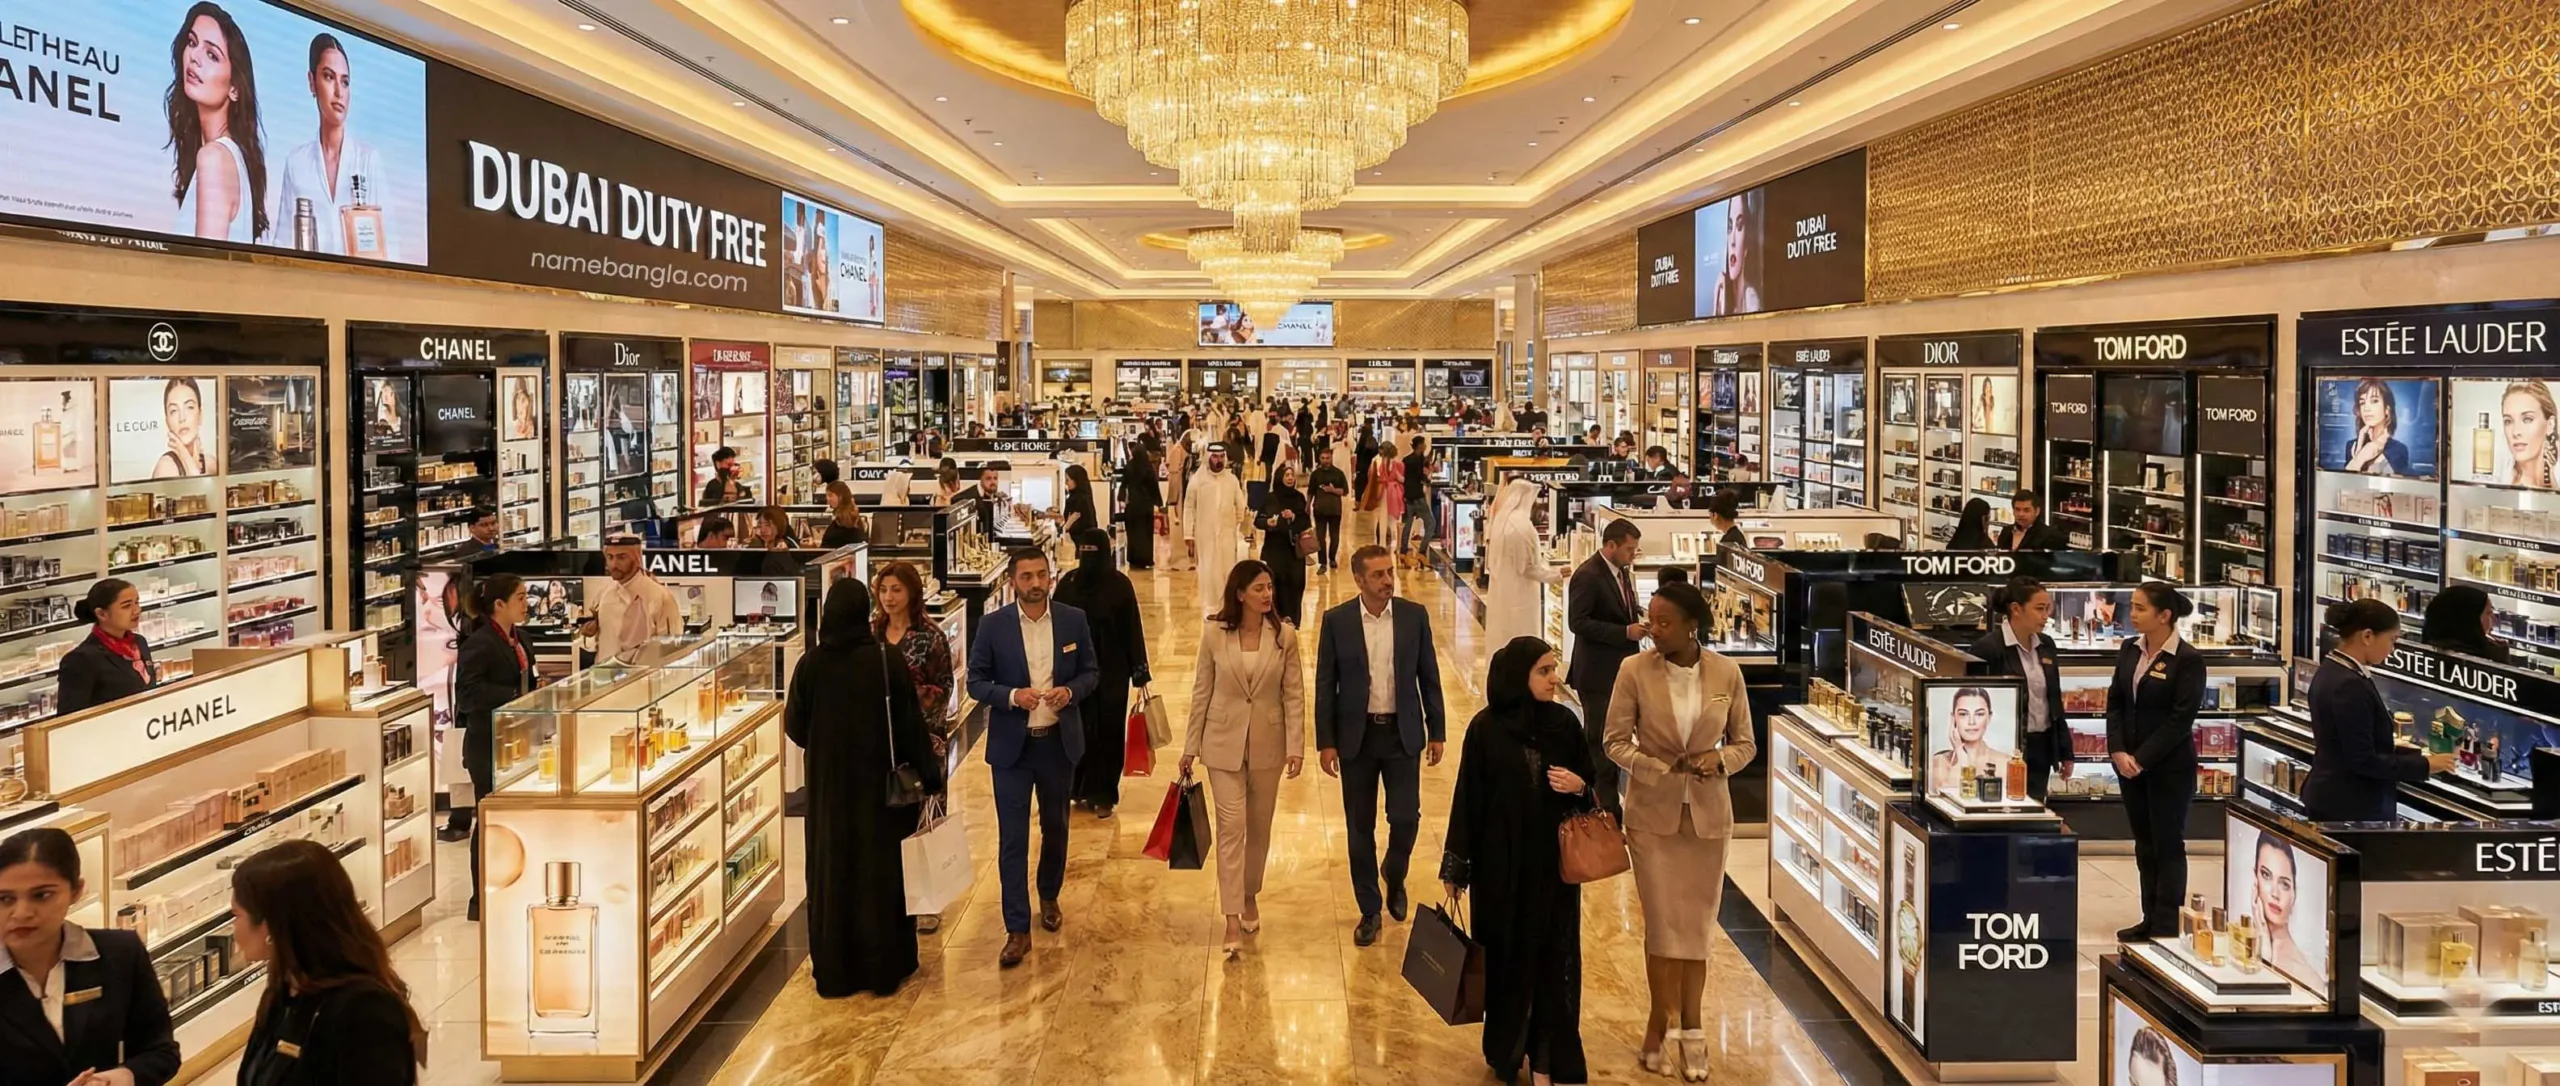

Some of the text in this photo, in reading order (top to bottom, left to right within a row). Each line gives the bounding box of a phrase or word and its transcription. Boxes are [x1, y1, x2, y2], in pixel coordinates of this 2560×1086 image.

[468, 140, 767, 267] DUBAI DUTY FREE
[1796, 213, 1826, 238] DUBAI
[1787, 232, 1837, 259] DUTY FREE
[420, 337, 496, 360] CHANEL
[2094, 334, 2187, 360] TOM FORD
[2341, 321, 2548, 356] ESTÉE LAUDER
[614, 342, 640, 366] Dior
[1924, 341, 1959, 364] DIOR
[438, 407, 476, 421] CHANEL
[2051, 402, 2087, 414] TOM FORD
[2205, 408, 2257, 422] TOM FORD
[643, 554, 718, 572] ANEL
[1902, 556, 2016, 575] TOM FORD
[1869, 627, 1937, 673] ESTÉE LAUDER
[2439, 660, 2518, 702] LAUDER
[146, 694, 237, 740] CHANEL
[2476, 837, 2560, 873] ESTÉ
[1966, 912, 2040, 940] TOM
[1958, 943, 2050, 971] FORD
[2538, 1001, 2560, 1014] EST
